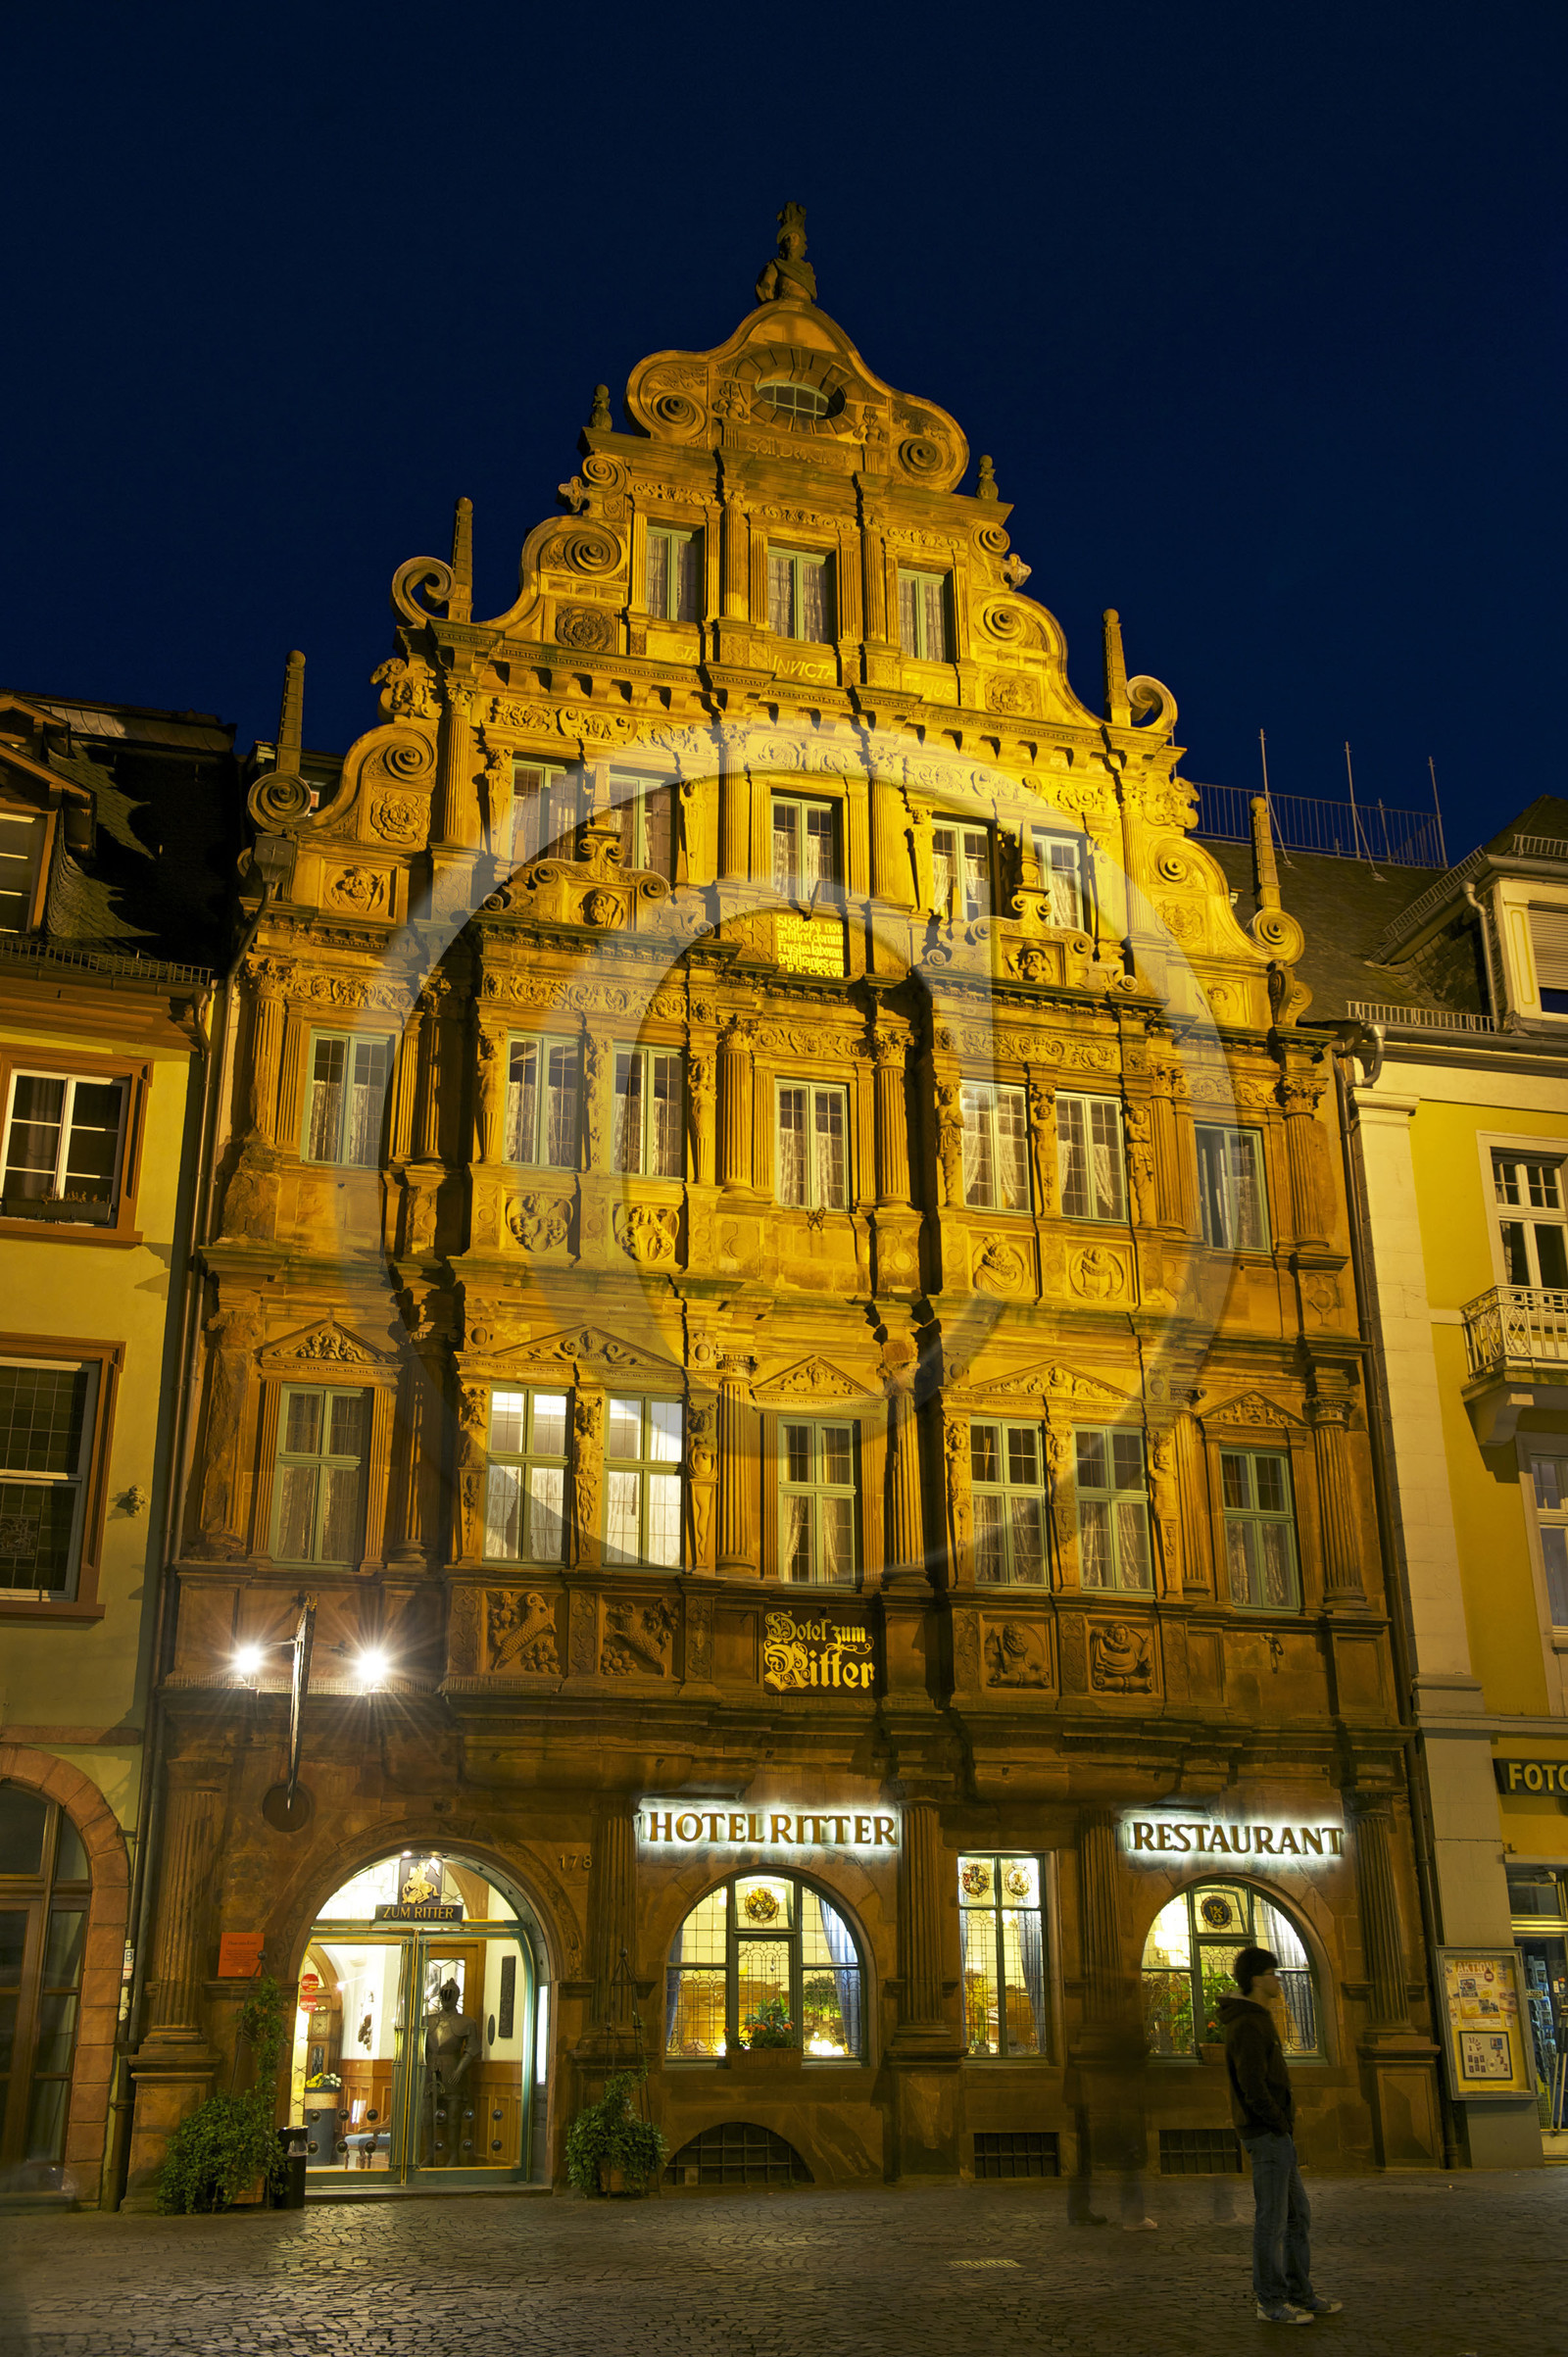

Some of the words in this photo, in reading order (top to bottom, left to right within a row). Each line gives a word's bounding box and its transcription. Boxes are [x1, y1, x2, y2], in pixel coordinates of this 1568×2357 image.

[764, 1610, 831, 1644] Hotel
[763, 1641, 875, 1692] Ritter
[649, 1811, 765, 1842] HOTEL
[770, 1814, 899, 1845] RITTER
[1133, 1822, 1345, 1855] RESTAURANT
[560, 1853, 593, 1870] 178
[383, 1906, 411, 1919] ZUM
[414, 1906, 454, 1919] RITTER
